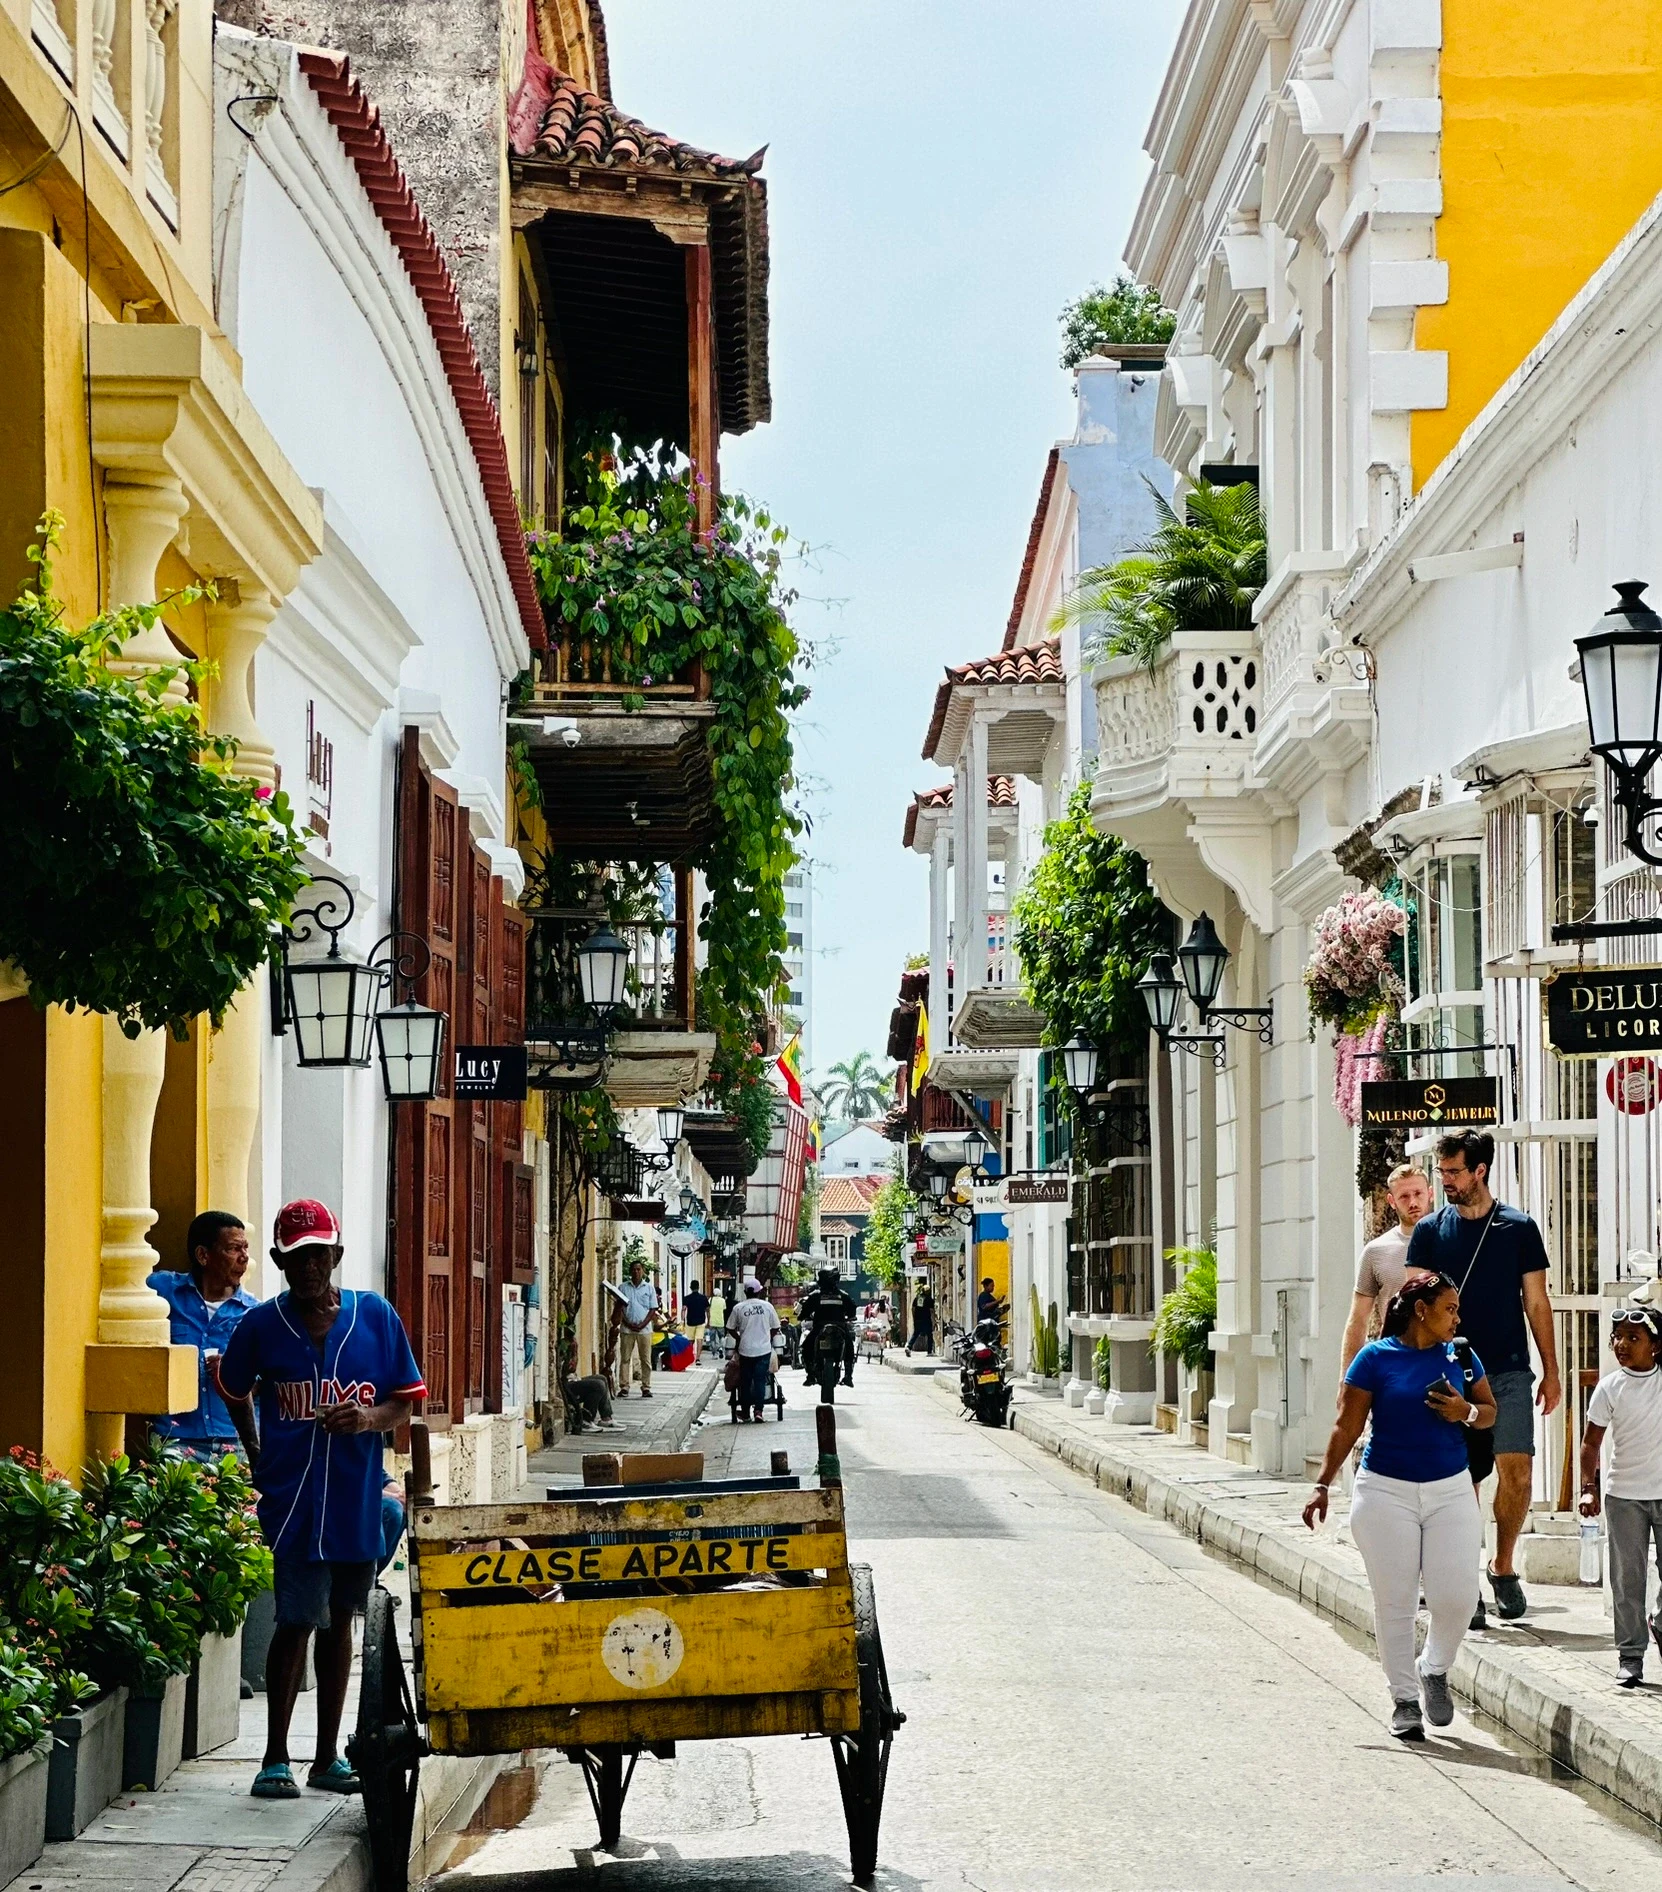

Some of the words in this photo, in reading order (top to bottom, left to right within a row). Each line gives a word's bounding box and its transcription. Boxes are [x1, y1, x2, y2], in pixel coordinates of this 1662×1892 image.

[1570, 983, 1662, 1014] DELU
[455, 1052, 501, 1085] Lucy
[1366, 1109, 1428, 1123] MILENIO
[1011, 1186, 1066, 1197] EMERALD
[465, 1547, 602, 1585] CLASE
[622, 1538, 790, 1579] APARTE
